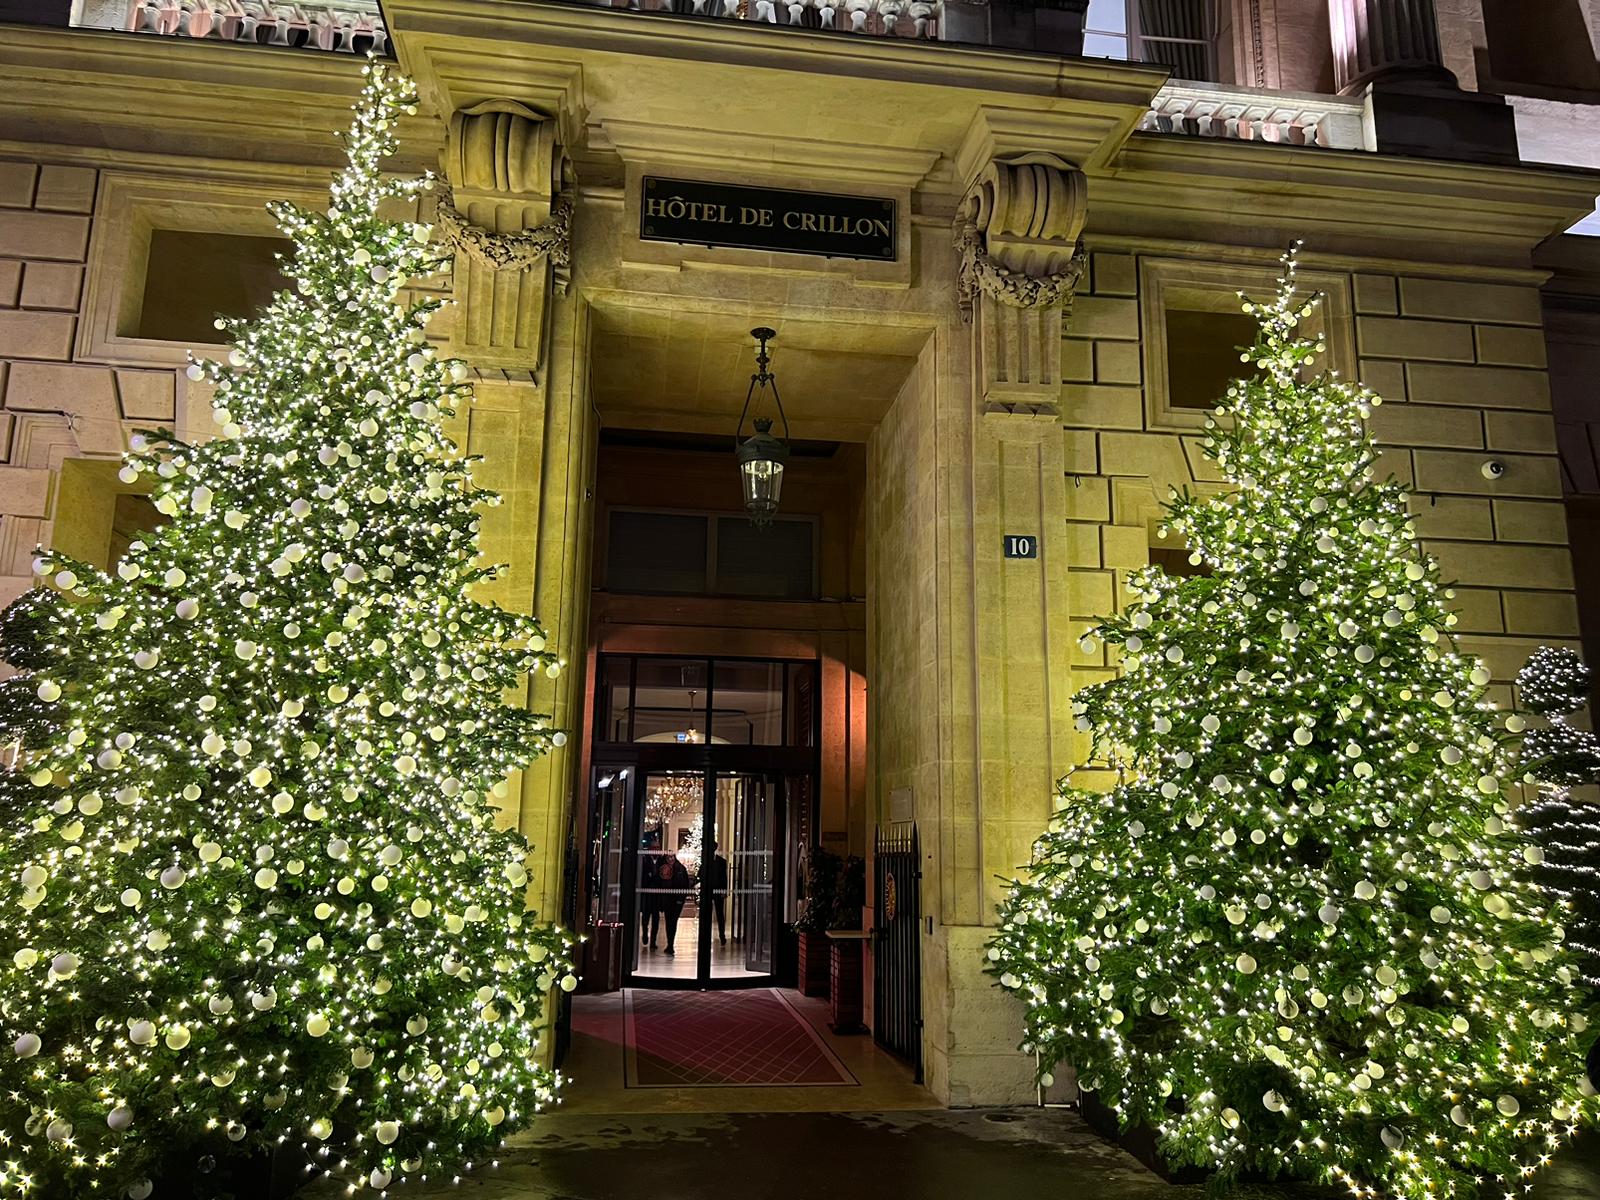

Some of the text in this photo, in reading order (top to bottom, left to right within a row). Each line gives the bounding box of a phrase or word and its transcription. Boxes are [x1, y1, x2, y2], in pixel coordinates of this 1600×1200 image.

[646, 196, 890, 238] HÔTEL DE CRILLON
[1011, 538, 1030, 555] 10
